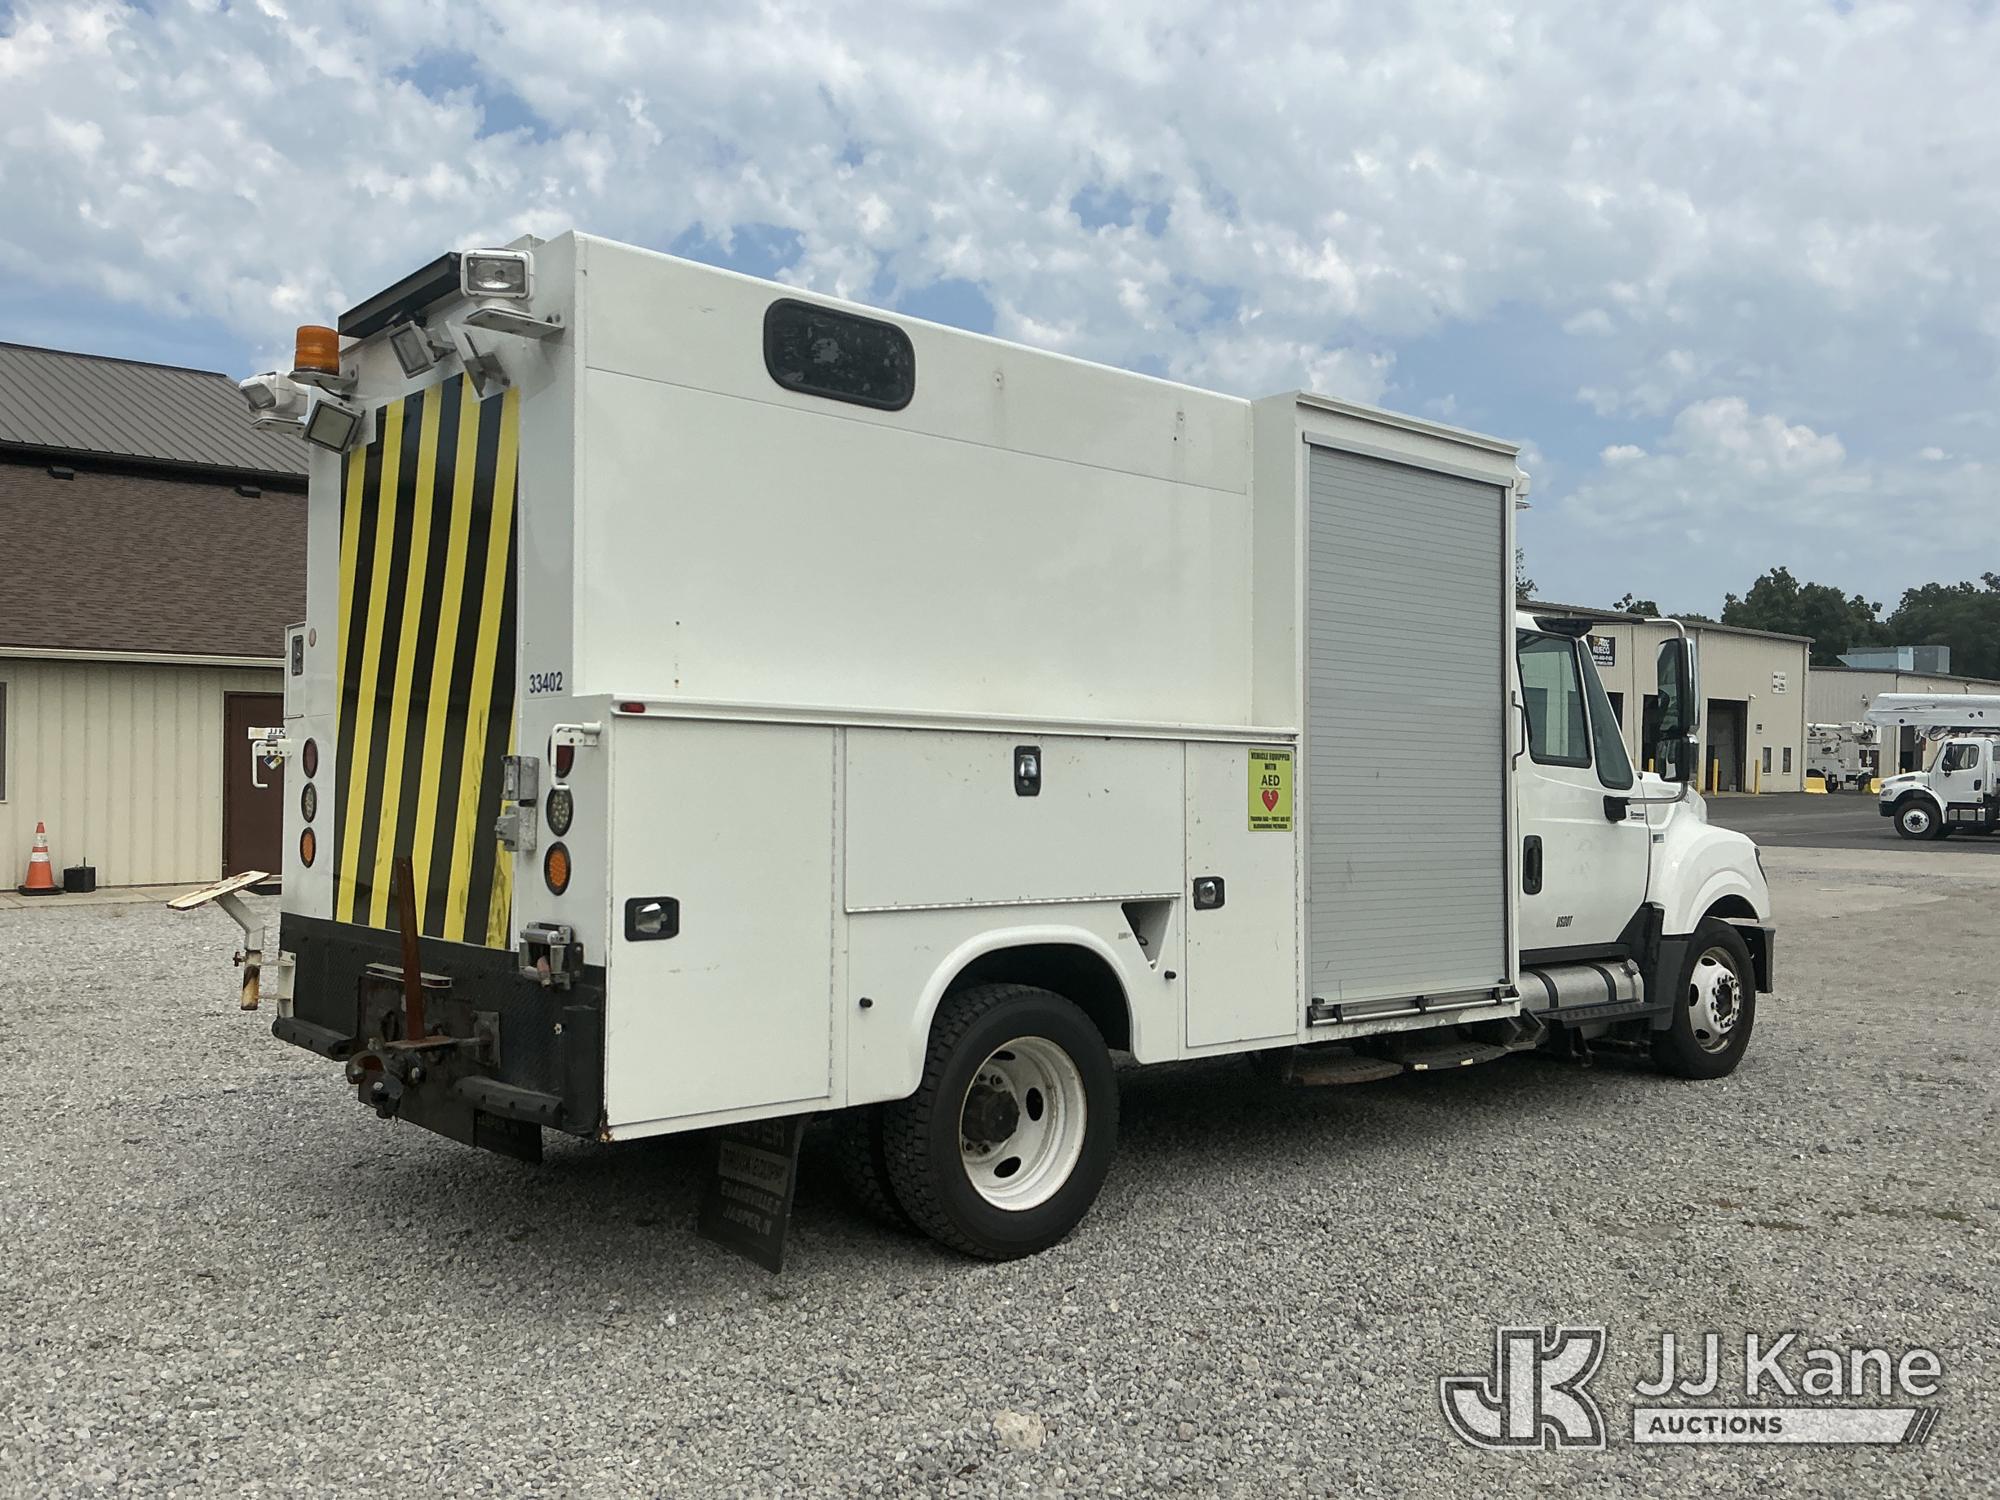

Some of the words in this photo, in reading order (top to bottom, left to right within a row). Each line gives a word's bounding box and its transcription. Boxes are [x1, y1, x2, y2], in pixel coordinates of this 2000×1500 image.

[529, 671, 563, 694] 33402
[1269, 752, 1290, 761] EQUIPPED
[1261, 774, 1280, 787] AED
[1556, 915, 1573, 928] USDOT
